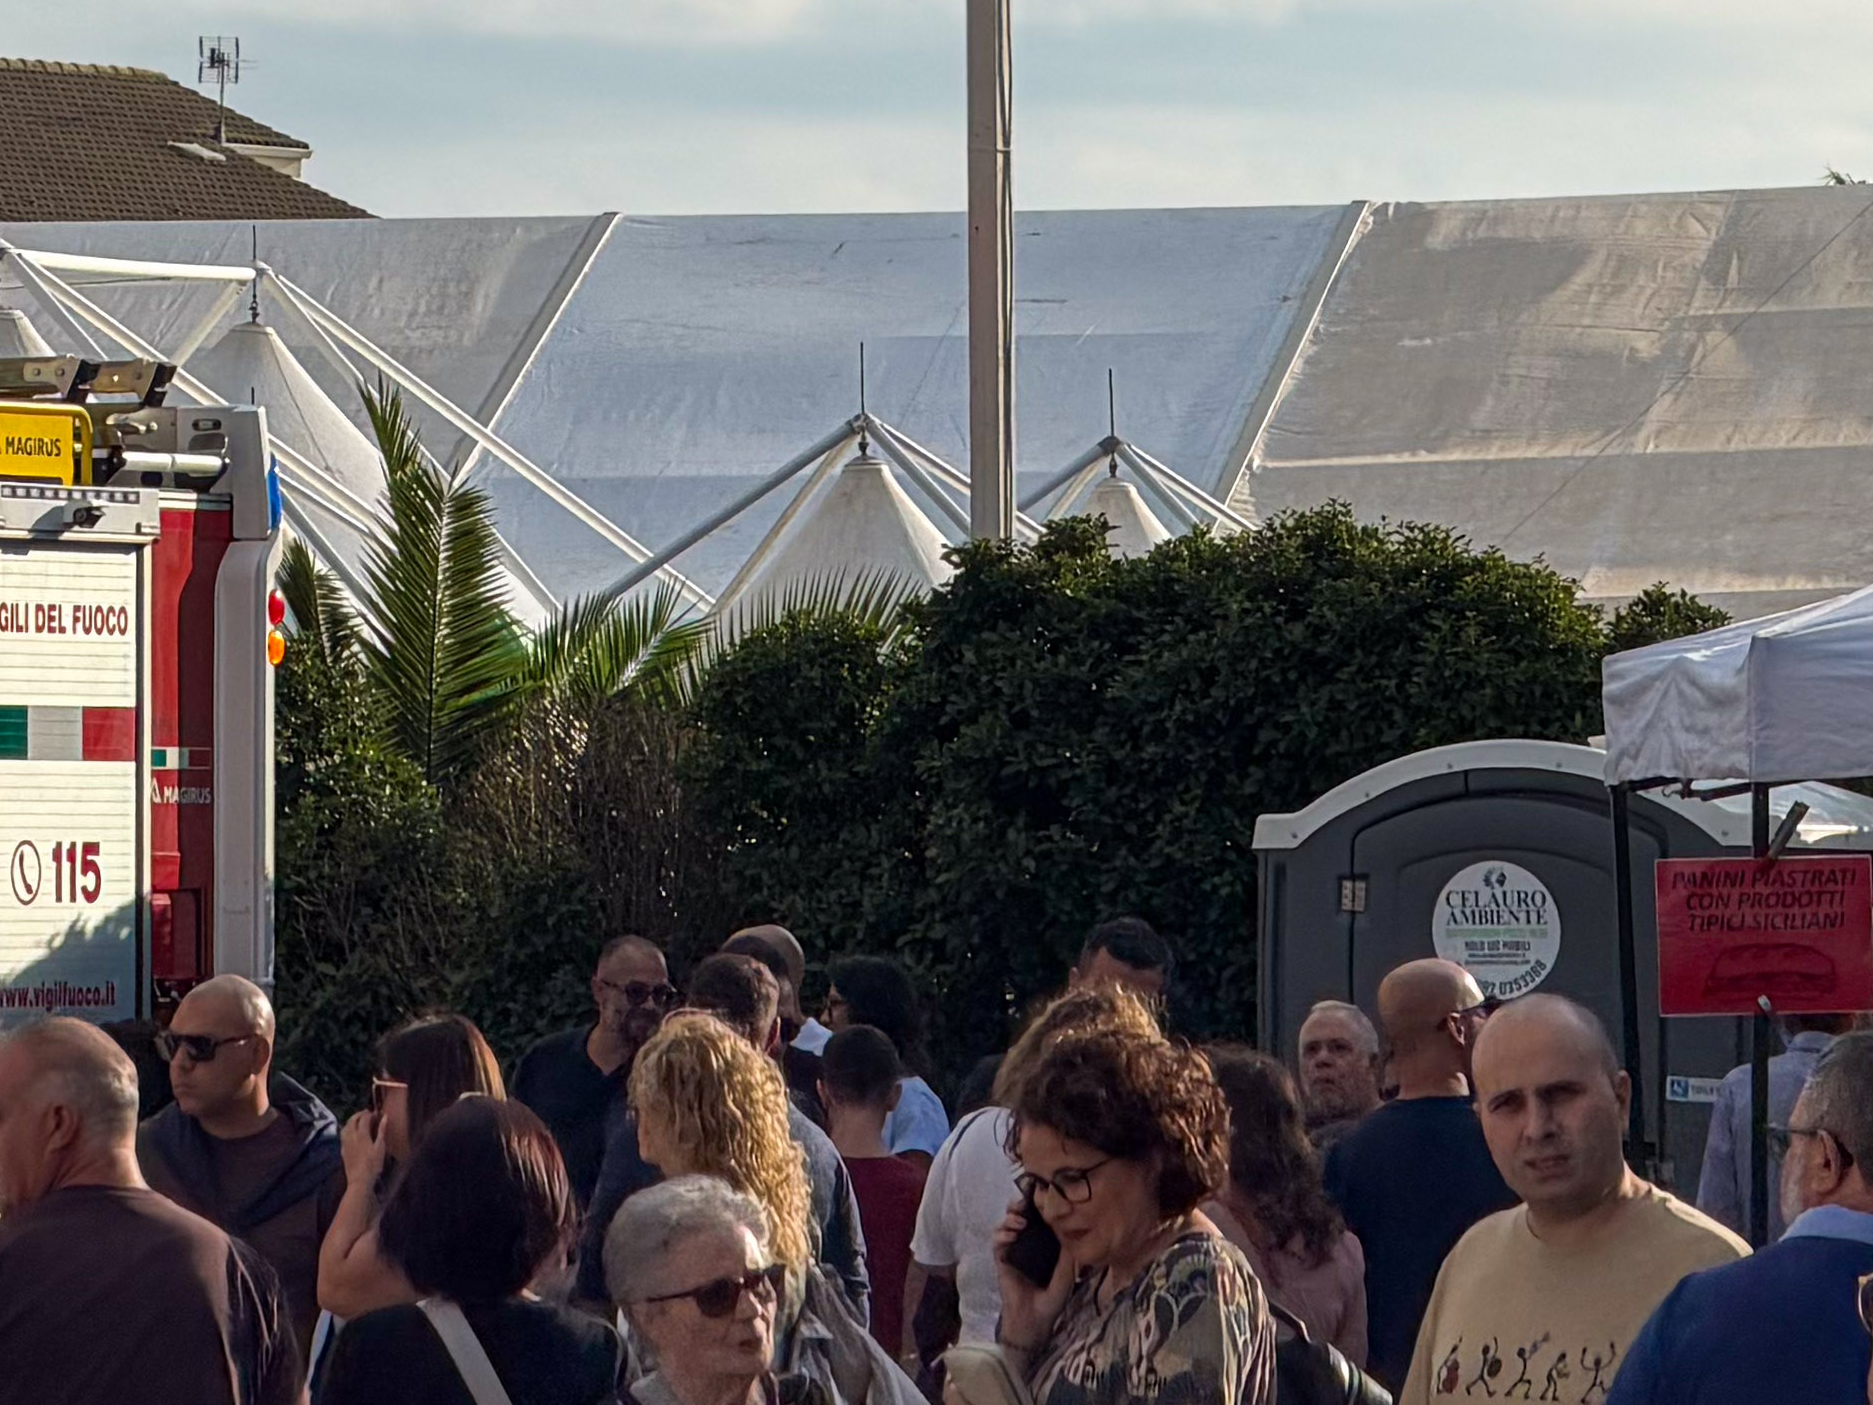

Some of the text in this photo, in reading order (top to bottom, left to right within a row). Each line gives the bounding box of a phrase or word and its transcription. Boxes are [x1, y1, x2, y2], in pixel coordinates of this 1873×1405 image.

[5, 436, 63, 459] MAGIRUS
[33, 602, 67, 636] DEL
[72, 602, 129, 637] FUOCO
[163, 786, 211, 804] MAGIRUS
[51, 841, 102, 904] 115
[1672, 867, 1857, 890] PANINI PIASTRATI
[1445, 889, 1547, 909] CELAURO
[1685, 889, 1846, 911] CON PRODOTTI
[1445, 908, 1548, 926] AMBIENTE
[1688, 911, 1846, 932] TIPICI SICILIANI
